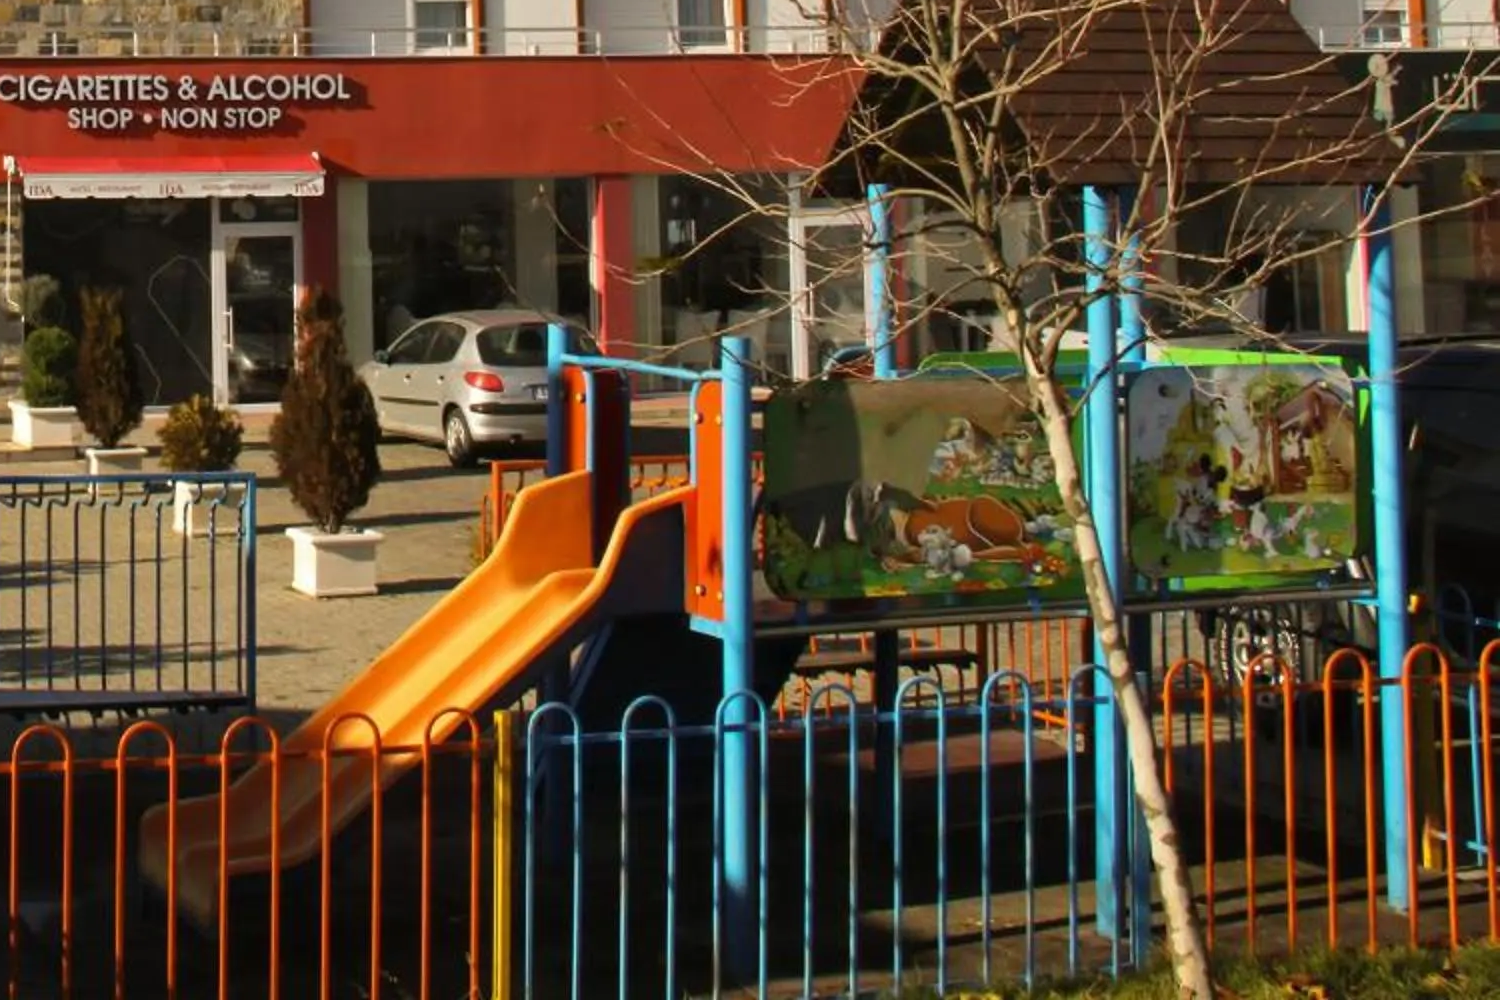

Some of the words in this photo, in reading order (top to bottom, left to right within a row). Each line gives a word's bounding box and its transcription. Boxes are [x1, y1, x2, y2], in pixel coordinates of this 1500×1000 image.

[177, 75, 198, 101] &
[207, 73, 352, 101] ALCOHOL
[66, 107, 134, 130] SHOP
[160, 107, 218, 130] NON
[223, 107, 283, 129] STOP
